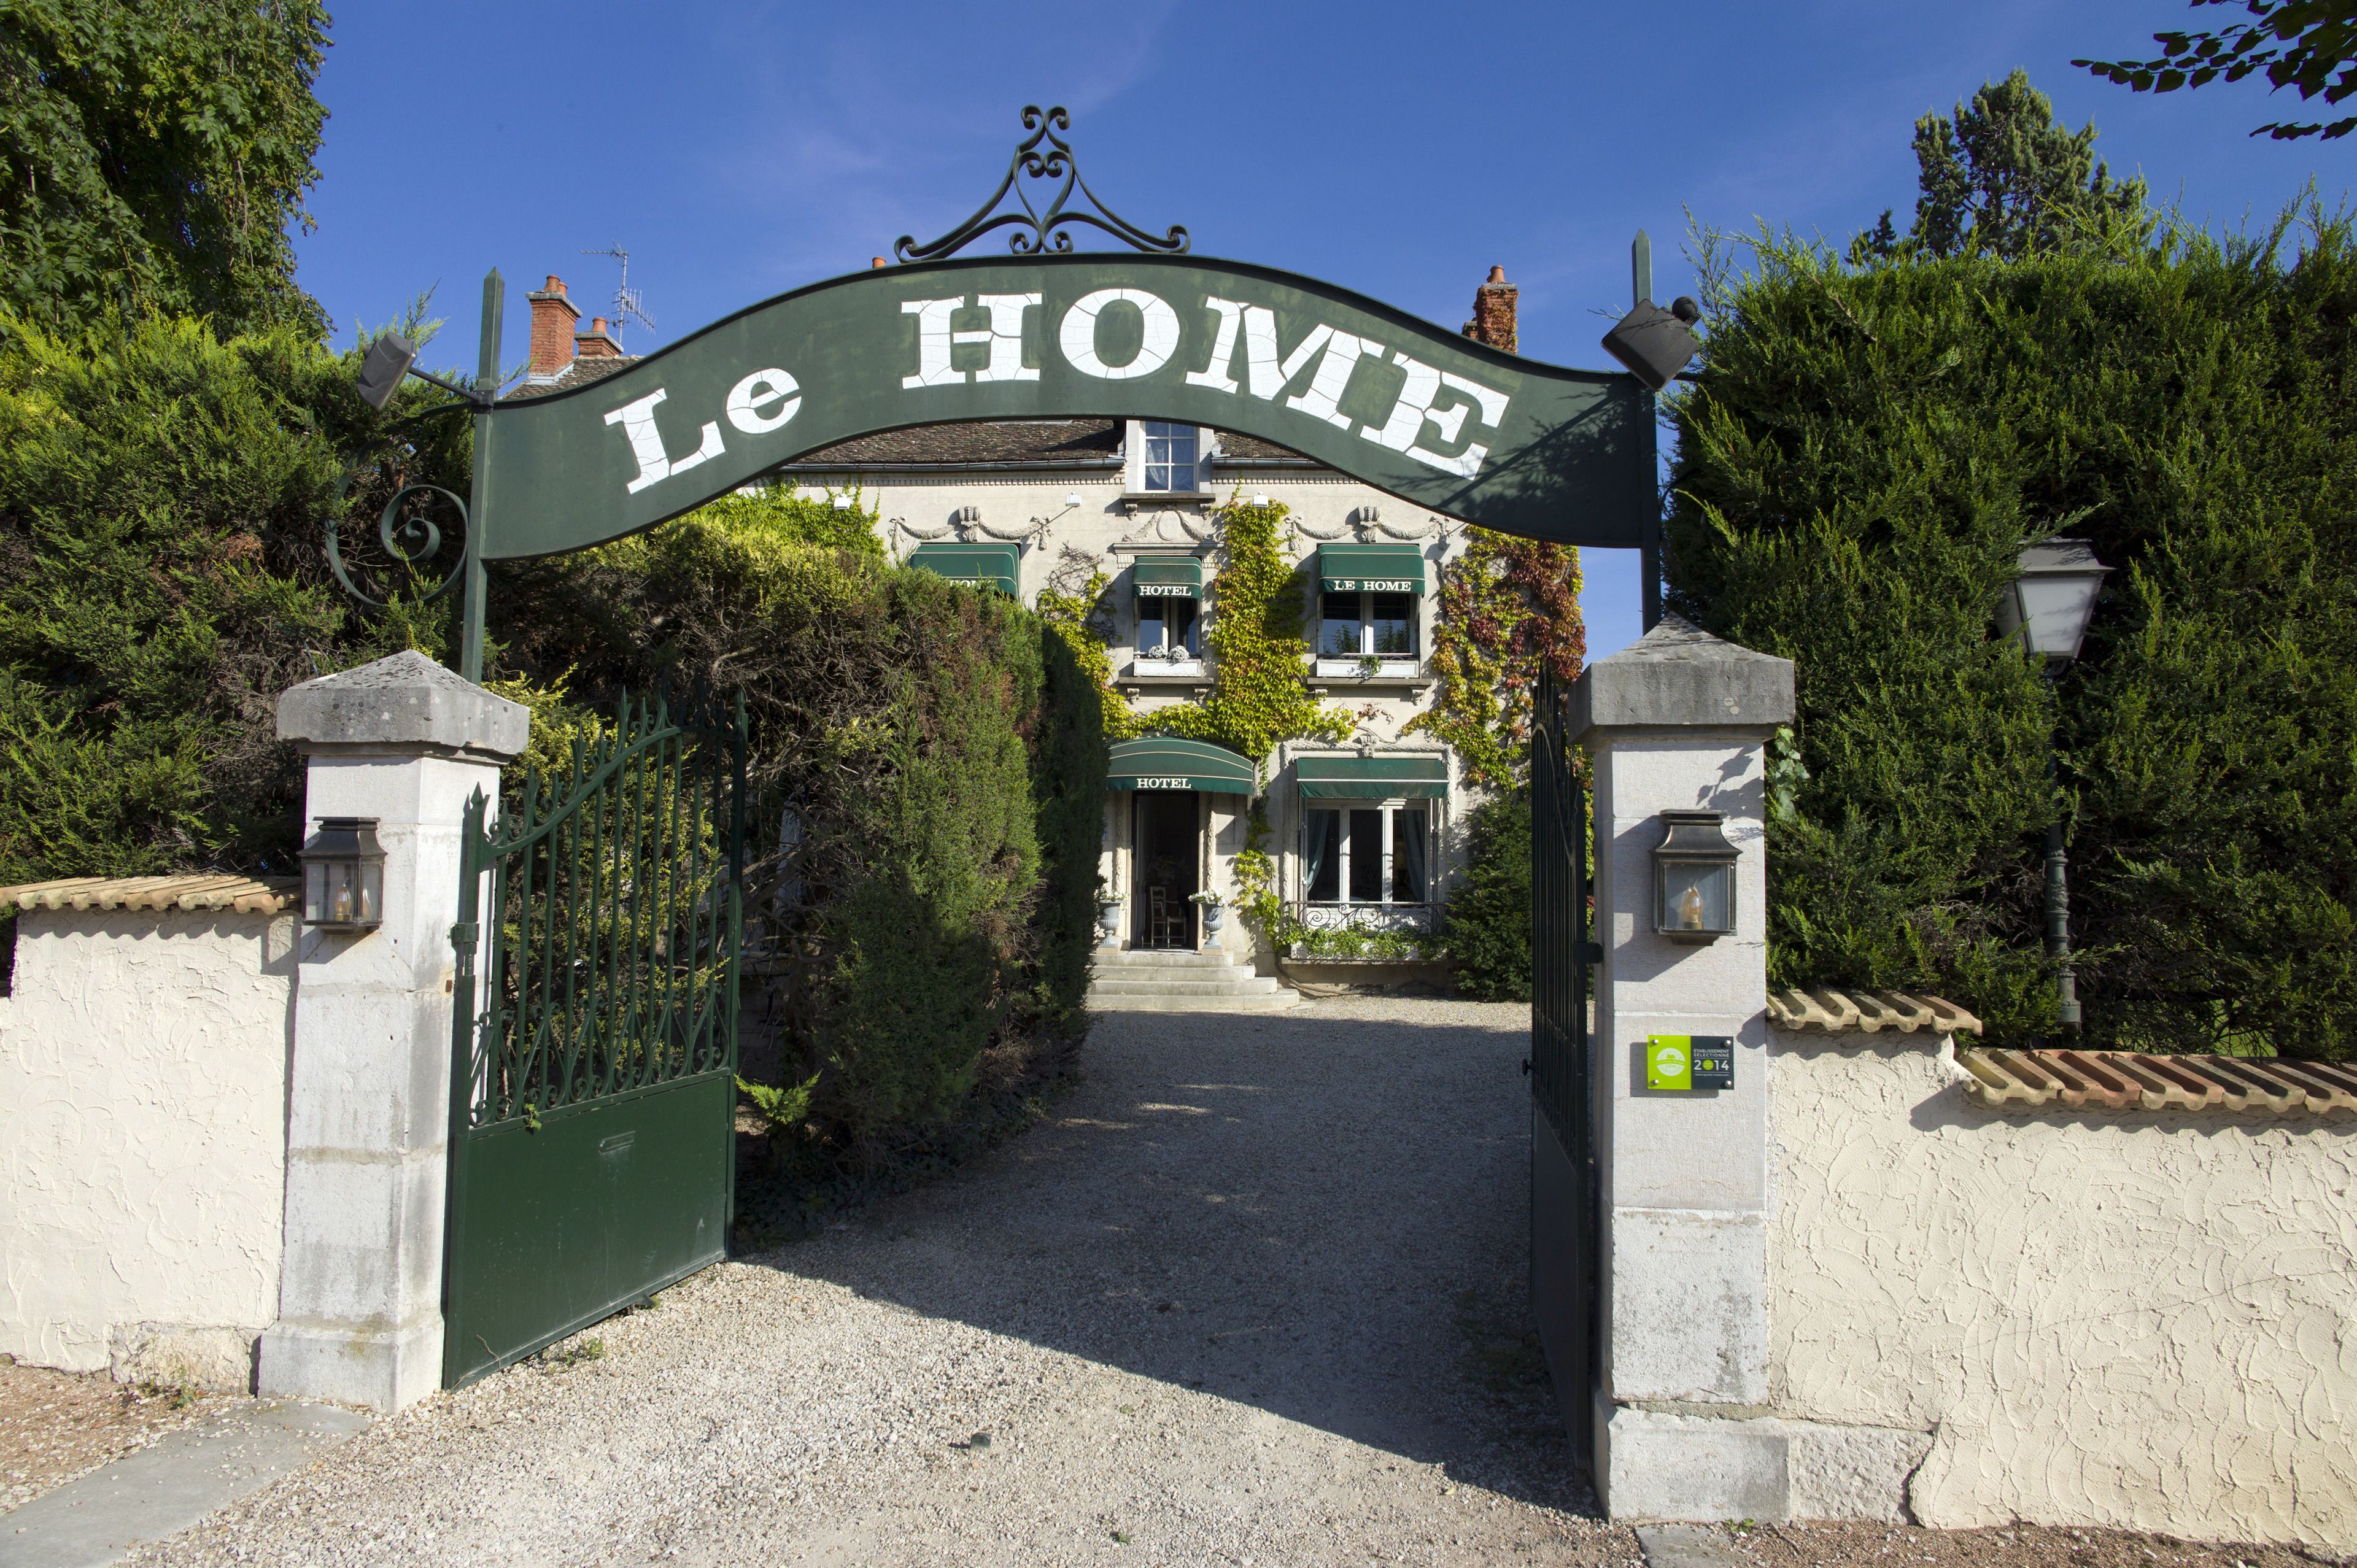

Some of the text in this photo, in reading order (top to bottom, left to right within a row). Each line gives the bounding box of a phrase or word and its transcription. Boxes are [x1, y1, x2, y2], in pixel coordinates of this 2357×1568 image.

[604, 288, 1511, 495] Le HOME
[1139, 585, 1192, 597] HOTEL
[1334, 580, 1412, 592] LE HOME
[1136, 778, 1191, 789] HOTEL
